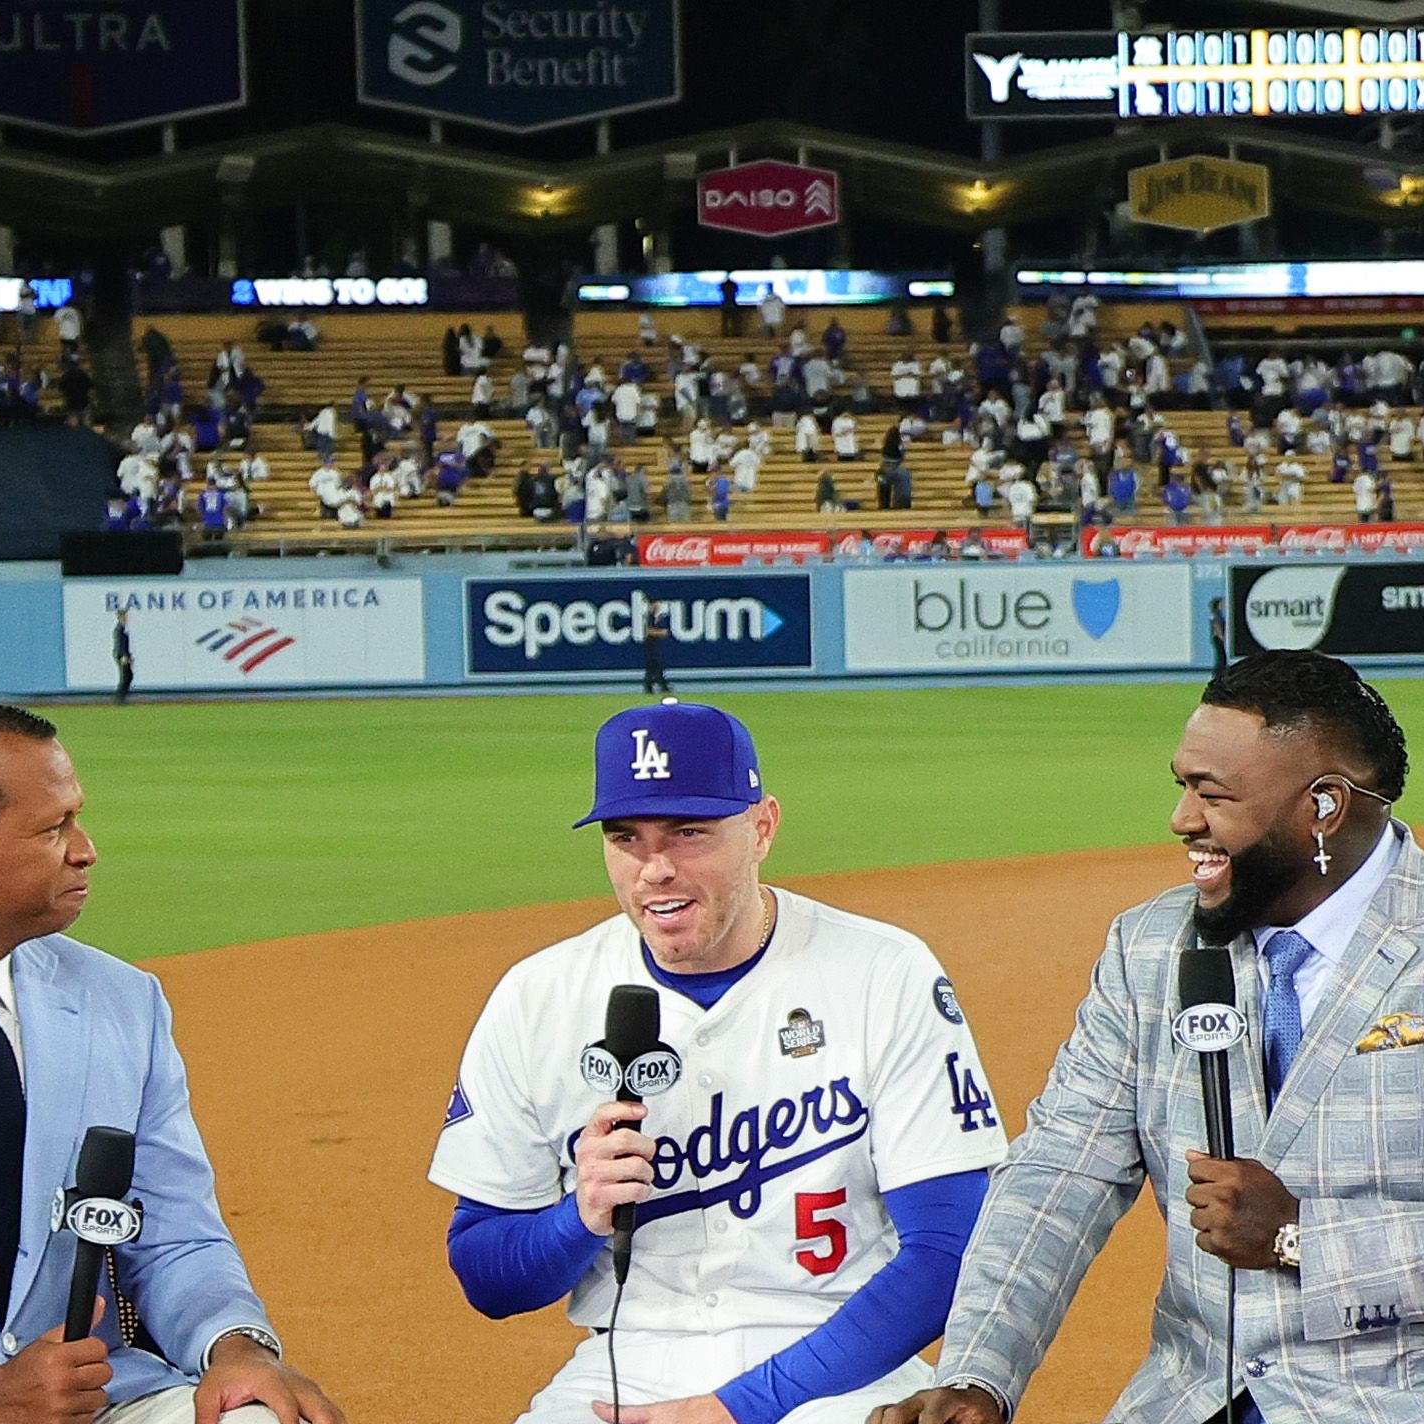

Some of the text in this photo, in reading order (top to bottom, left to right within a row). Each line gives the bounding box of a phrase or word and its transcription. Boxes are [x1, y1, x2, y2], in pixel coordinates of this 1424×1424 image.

[482, 0, 645, 47] Security
[487, 49, 627, 86] Benefit
[705, 190, 796, 208] DAISO
[254, 278, 334, 305] WINS
[333, 278, 376, 305] TO
[105, 588, 381, 612] BANK OF AMERICA
[913, 579, 1051, 632] blue
[1250, 595, 1325, 618] smart
[936, 635, 1069, 659] california
[631, 730, 670, 779] LA
[780, 1025, 820, 1041] WORLD
[1188, 1013, 1231, 1033] FOX
[783, 1036, 820, 1050] SERIES
[1189, 1032, 1232, 1042] SPORTS
[588, 1055, 612, 1079] FOX
[638, 1060, 669, 1081] FOX
[637, 1077, 671, 1089] SPORTS
[946, 1052, 997, 1133] LA
[567, 1076, 869, 1219] odgers
[84, 1206, 124, 1228] FOX
[81, 1224, 123, 1237] SPORTS
[795, 1187, 847, 1276] 5
